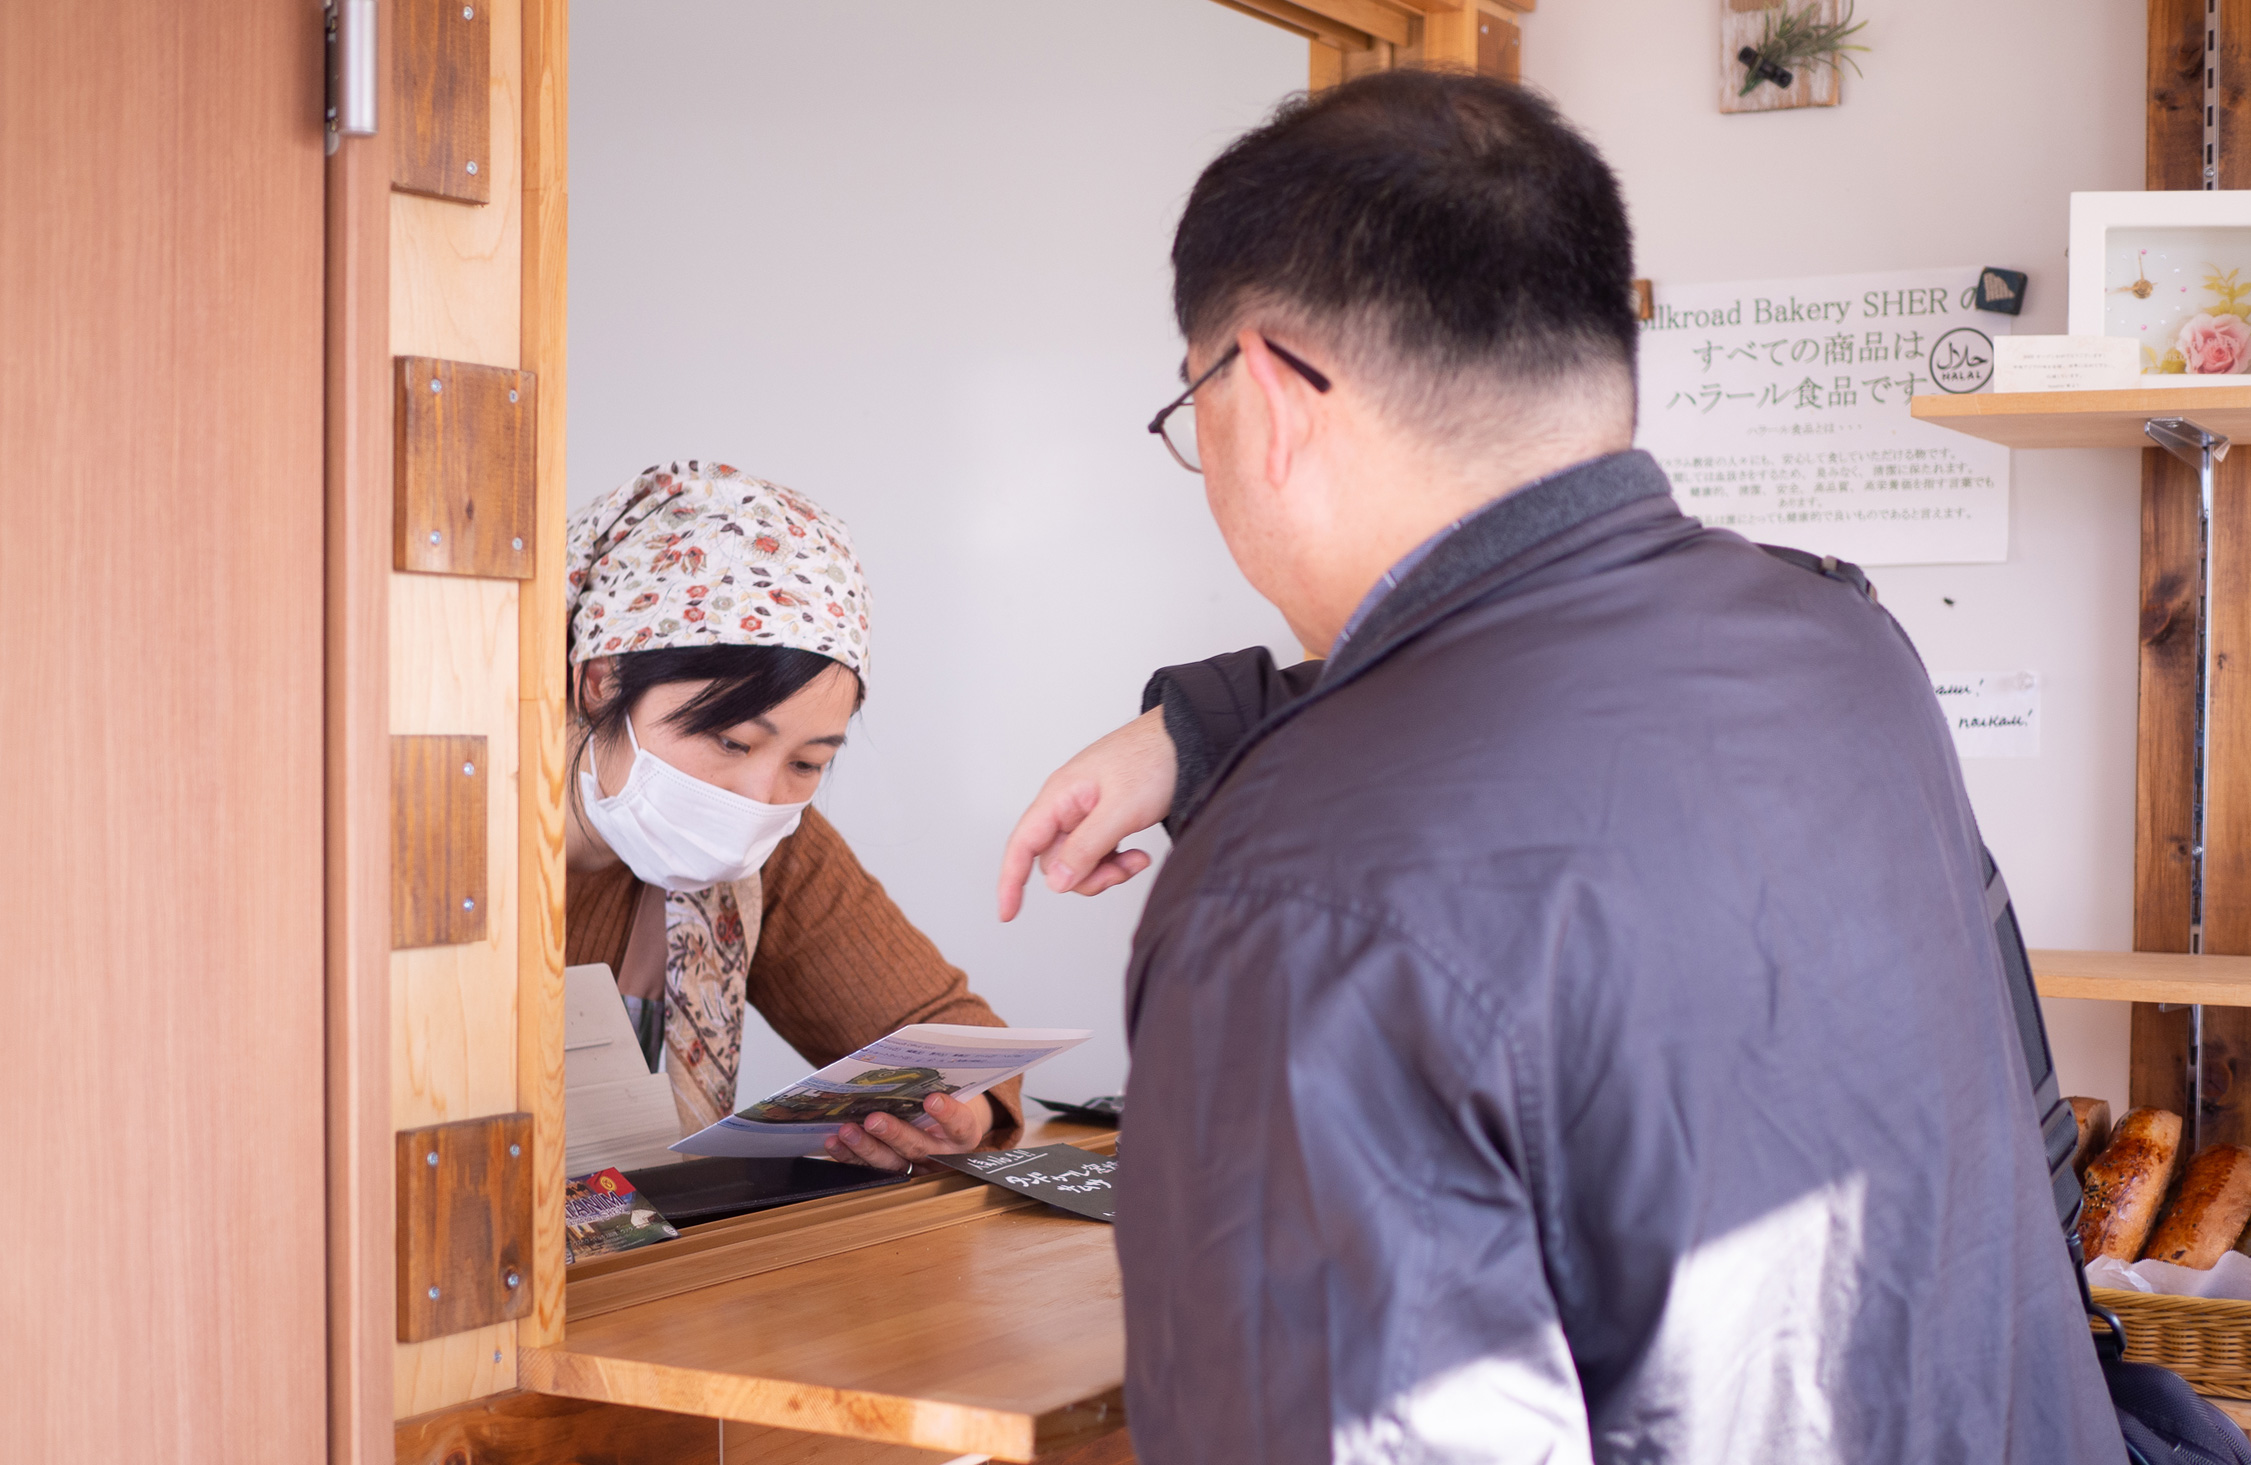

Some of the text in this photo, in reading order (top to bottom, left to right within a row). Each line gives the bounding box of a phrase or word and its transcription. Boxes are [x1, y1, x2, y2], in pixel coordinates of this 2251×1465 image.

[1638, 299, 1742, 332] ilkroad
[1754, 296, 1851, 324] Bakery
[1863, 287, 1949, 318] SHER
[1692, 330, 1925, 373] すべての商品は
[1936, 342, 1988, 371] حلال
[1665, 371, 1932, 415] ハラール食品です
[1942, 371, 1982, 381] HALAL
[565, 1190, 627, 1219] TANIM
